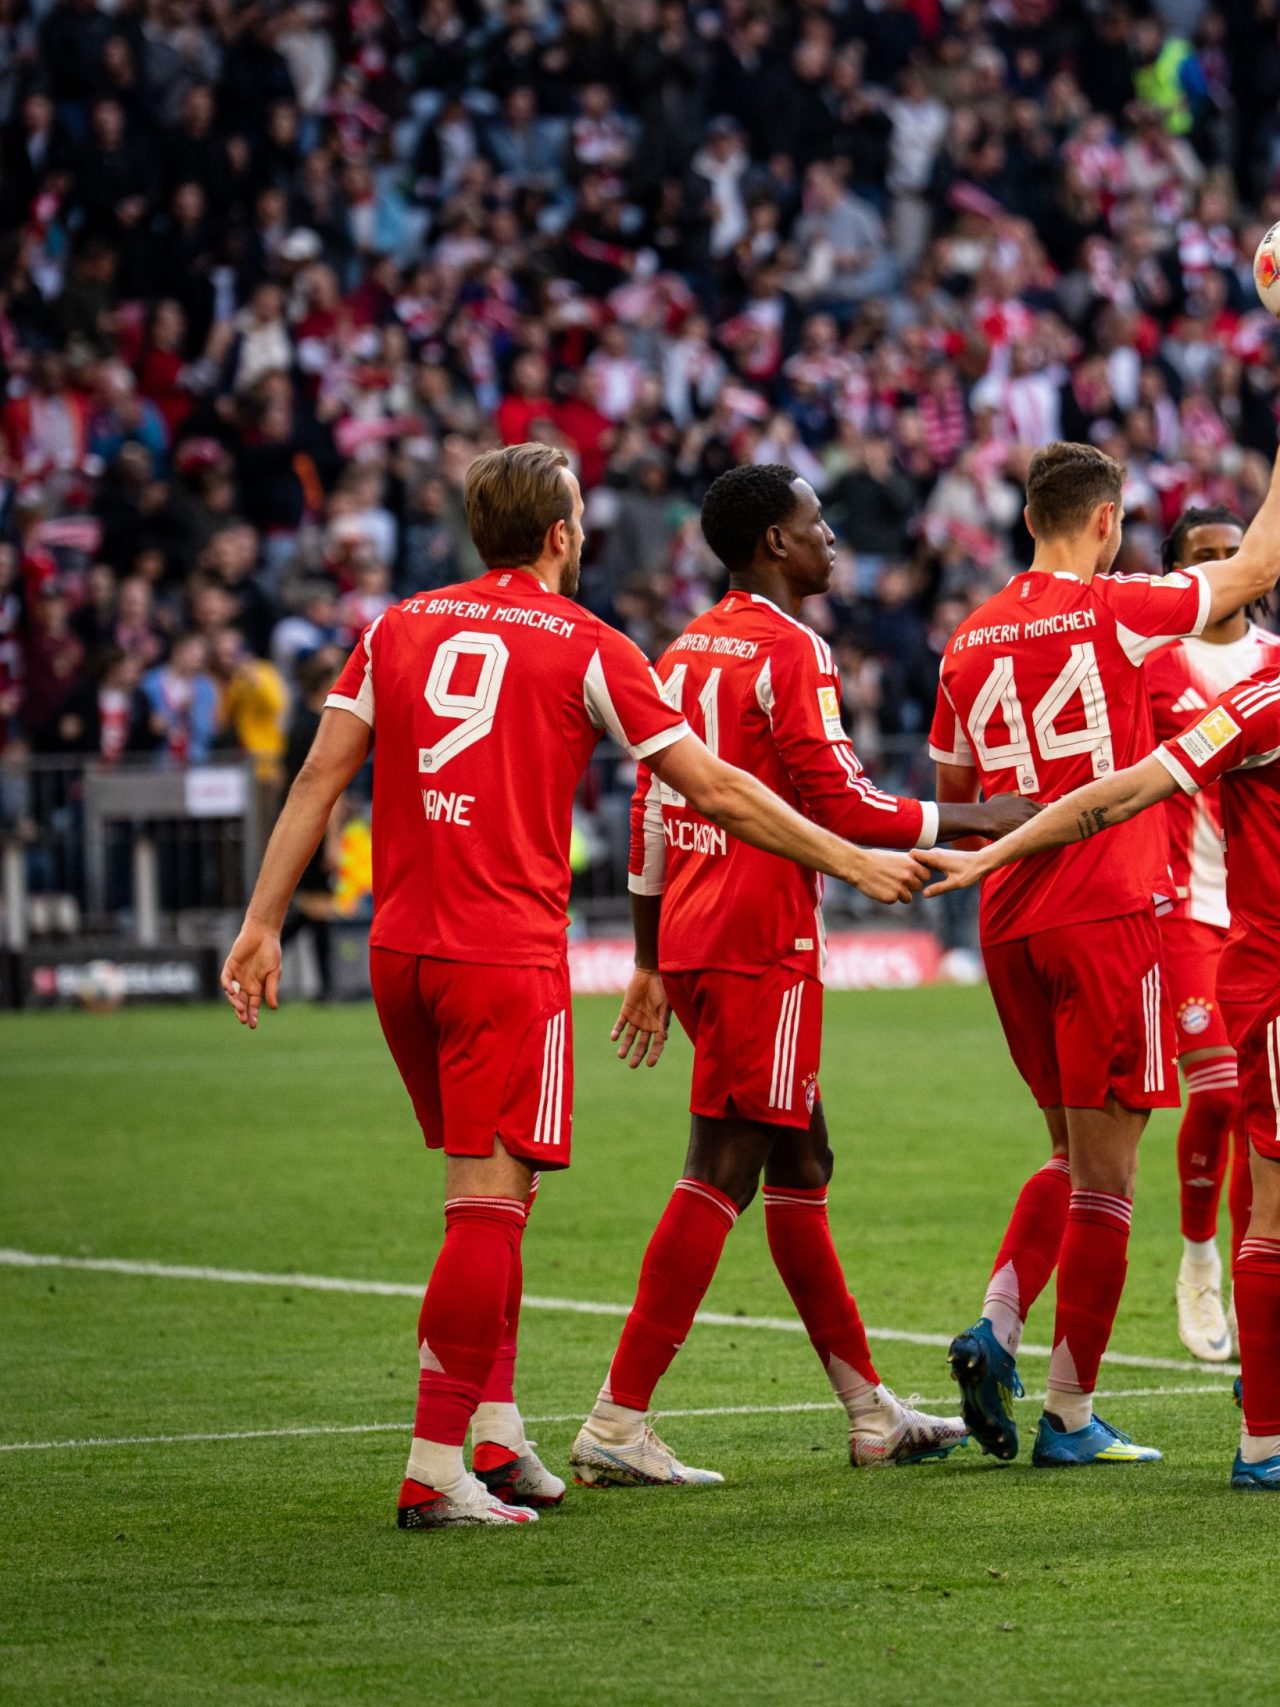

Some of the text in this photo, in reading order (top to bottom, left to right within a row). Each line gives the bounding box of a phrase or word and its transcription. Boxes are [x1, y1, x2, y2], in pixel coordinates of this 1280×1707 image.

[402, 599, 424, 614] FC
[425, 599, 490, 620] BAYERN
[953, 634, 966, 654] FC
[967, 623, 1020, 648] BAYERN
[418, 630, 509, 774] 9
[967, 641, 1115, 795] 44
